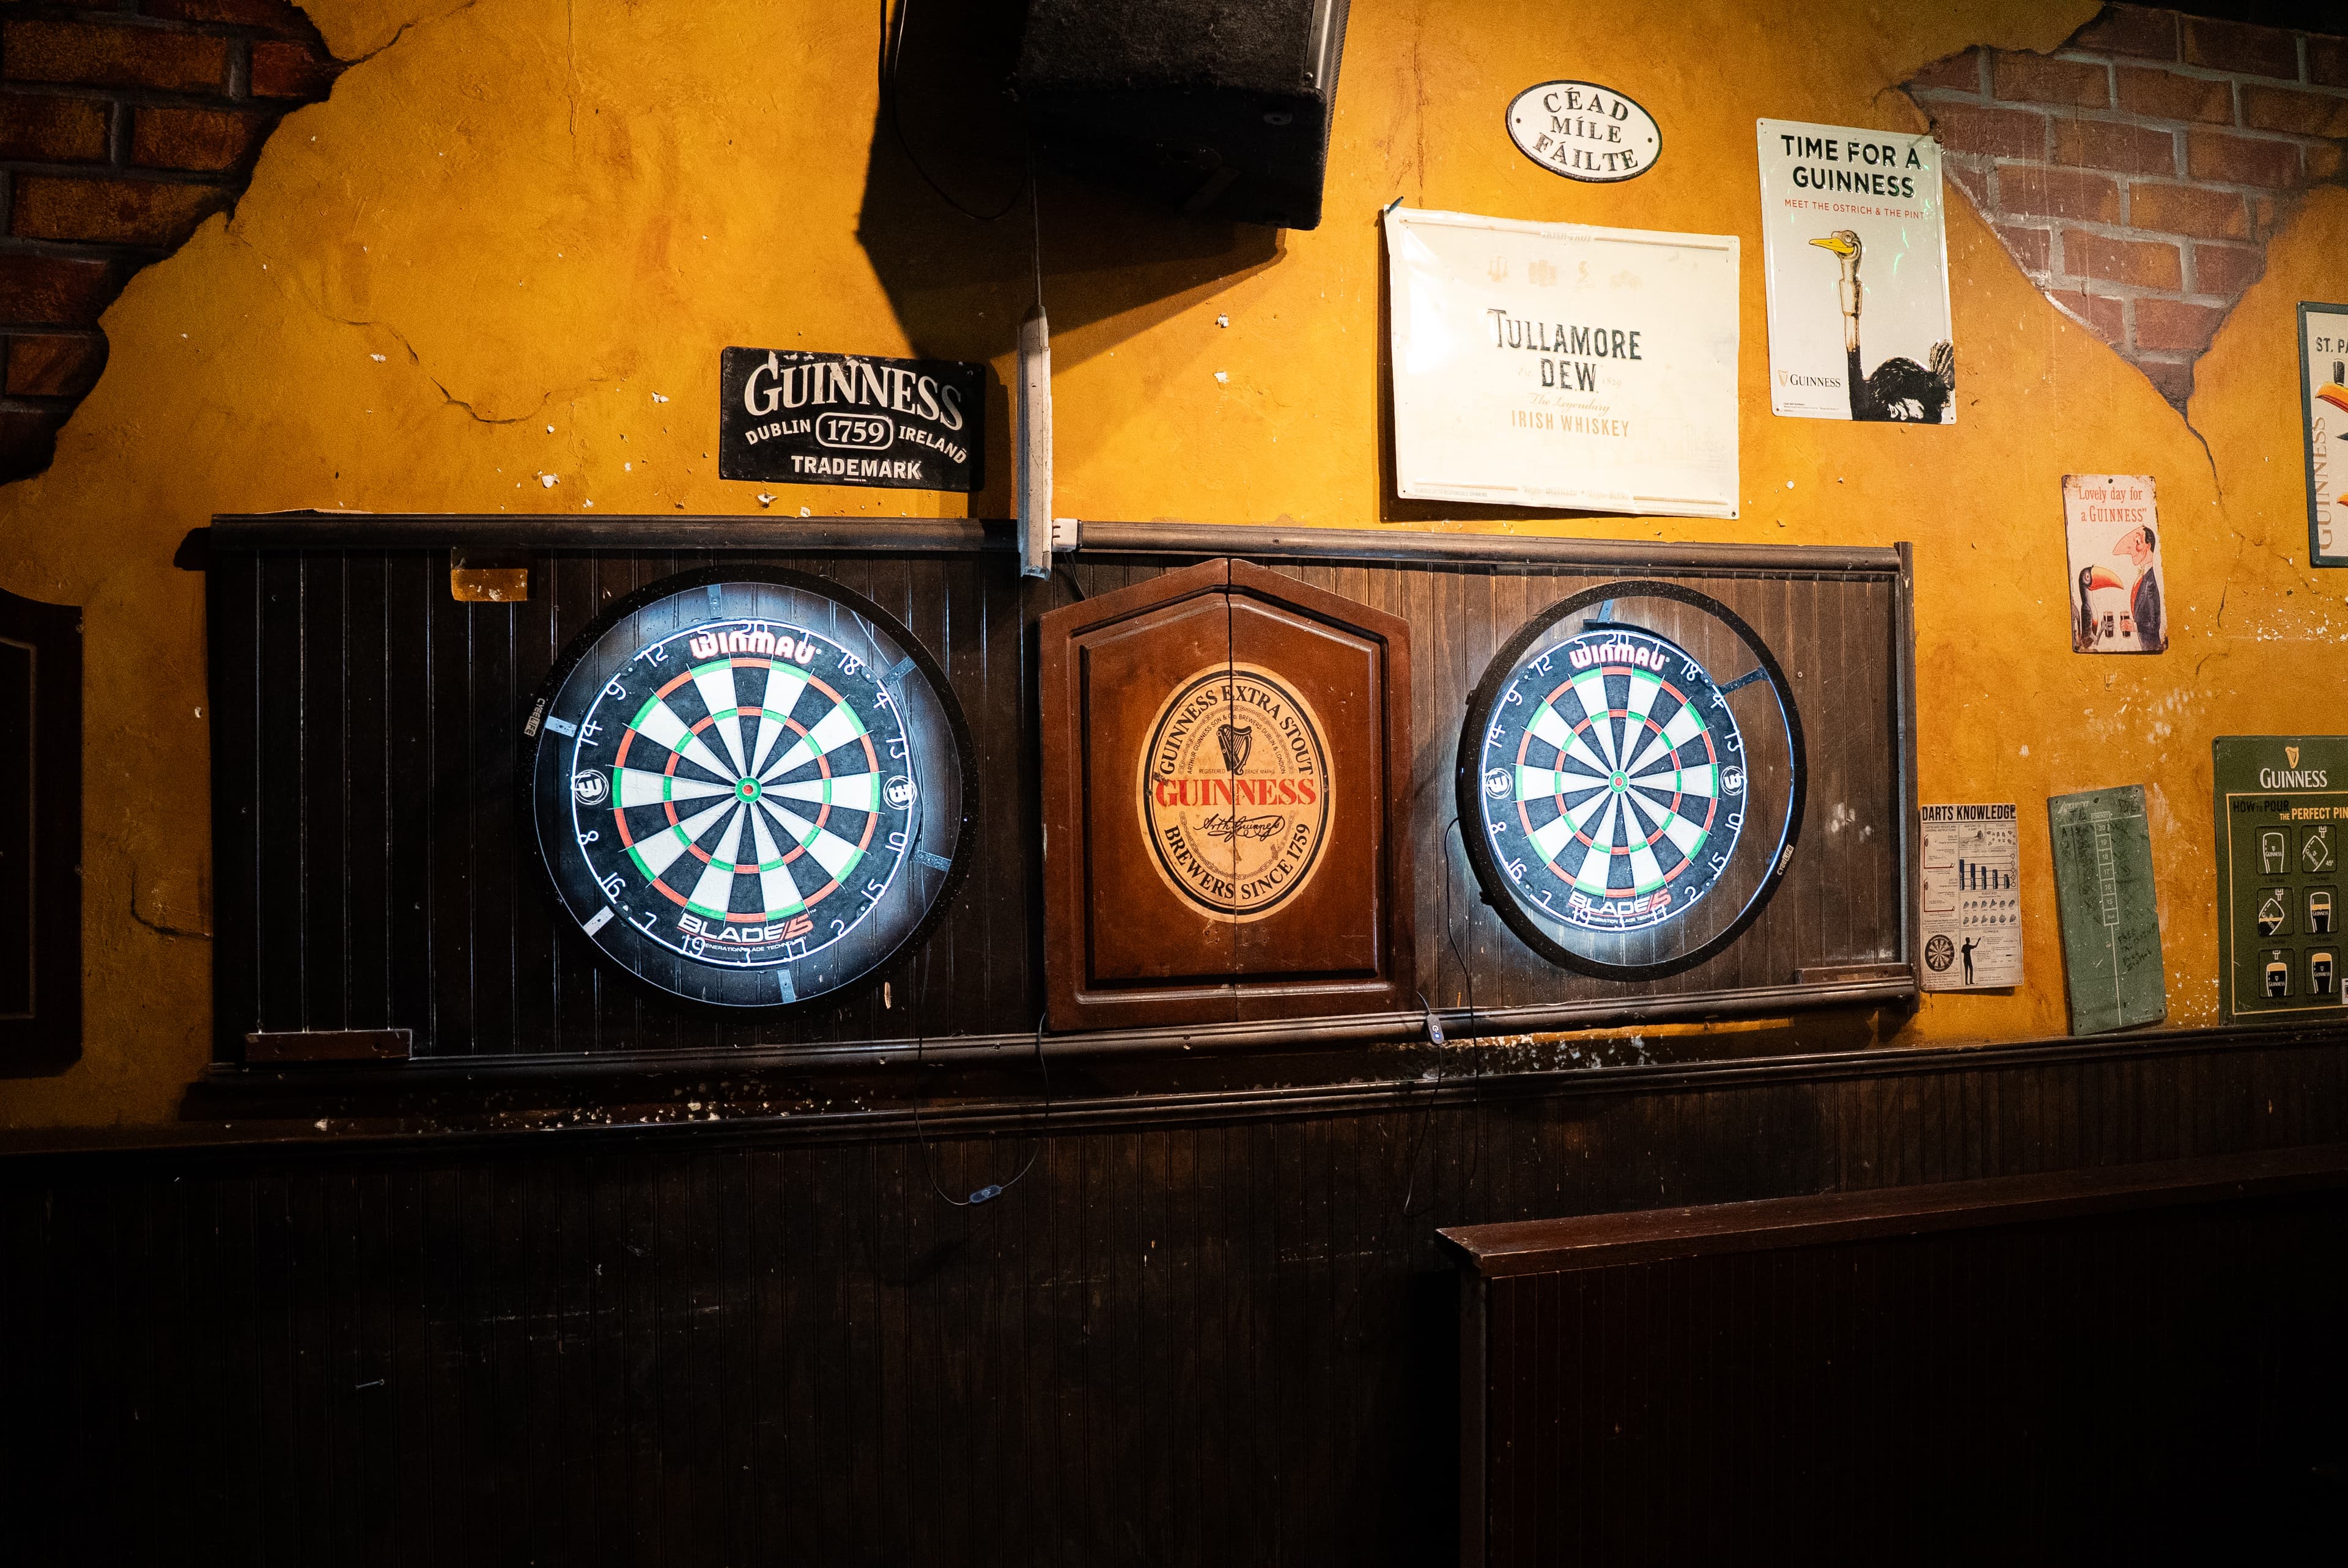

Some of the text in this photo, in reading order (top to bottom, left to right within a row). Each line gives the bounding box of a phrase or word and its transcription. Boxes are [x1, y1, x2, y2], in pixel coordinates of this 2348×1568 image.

[1543, 87, 1628, 122] CÉAD
[1551, 116, 1621, 143] MÍLE
[1533, 133, 1638, 172] FÁILTE
[1781, 134, 1922, 170] TIME FOR A
[1793, 166, 1915, 198] GUINNESS
[1785, 199, 1807, 208] MEET
[1812, 202, 1829, 211] THE
[1834, 204, 1872, 215] OSTRICH
[1885, 208, 1901, 217] THE
[1905, 210, 1924, 219] PINT
[1487, 308, 1642, 360] TULLAMORE
[2316, 336, 2333, 352] ST.
[1602, 377, 1622, 388] 1829
[1790, 374, 1840, 388] GUINNESS
[744, 360, 964, 431] GUINNESS
[1527, 392, 1610, 417] The Legendary
[1512, 410, 1630, 437] IRISH WHISKEY
[745, 419, 967, 464] DUBLIN 1759 IRELAND
[791, 455, 922, 480] TRADEMARK
[2079, 487, 2143, 503] Lovely day for
[2312, 417, 2333, 550] GUINNESS
[2081, 512, 2087, 522] a
[640, 644, 863, 675] 12 18
[1530, 655, 1700, 682] 12 18
[605, 680, 891, 710] 9 4
[1507, 688, 1725, 710] 9 4
[578, 721, 603, 746] 14
[1160, 685, 1313, 775] GUINNESS EXTRA STOUT
[1488, 724, 1505, 748] 14
[1187, 751, 1197, 775] ARTHUR
[1194, 726, 1212, 751] GUINNESS
[1211, 718, 1222, 727] SON
[1239, 714, 1262, 729] BREWERS
[1262, 728, 1276, 746] DUBLIN
[1276, 752, 1286, 774] LONDON
[2259, 768, 2328, 789] GUINNESS
[1156, 779, 1316, 806] GUINNESS
[1922, 804, 2016, 820] DARTS KNOWLEDGE
[2233, 801, 2256, 812] HOW
[2264, 800, 2289, 812] POUR
[2292, 808, 2330, 820] PERFECT
[1491, 813, 1741, 834] 8 10
[578, 830, 906, 853] 8 10
[1164, 823, 1310, 899] BREWERS SINCE 1759
[1507, 852, 1726, 881] 16 15
[603, 872, 885, 903] 16 15
[1541, 890, 1552, 907] 7
[640, 911, 846, 935] 7 2
